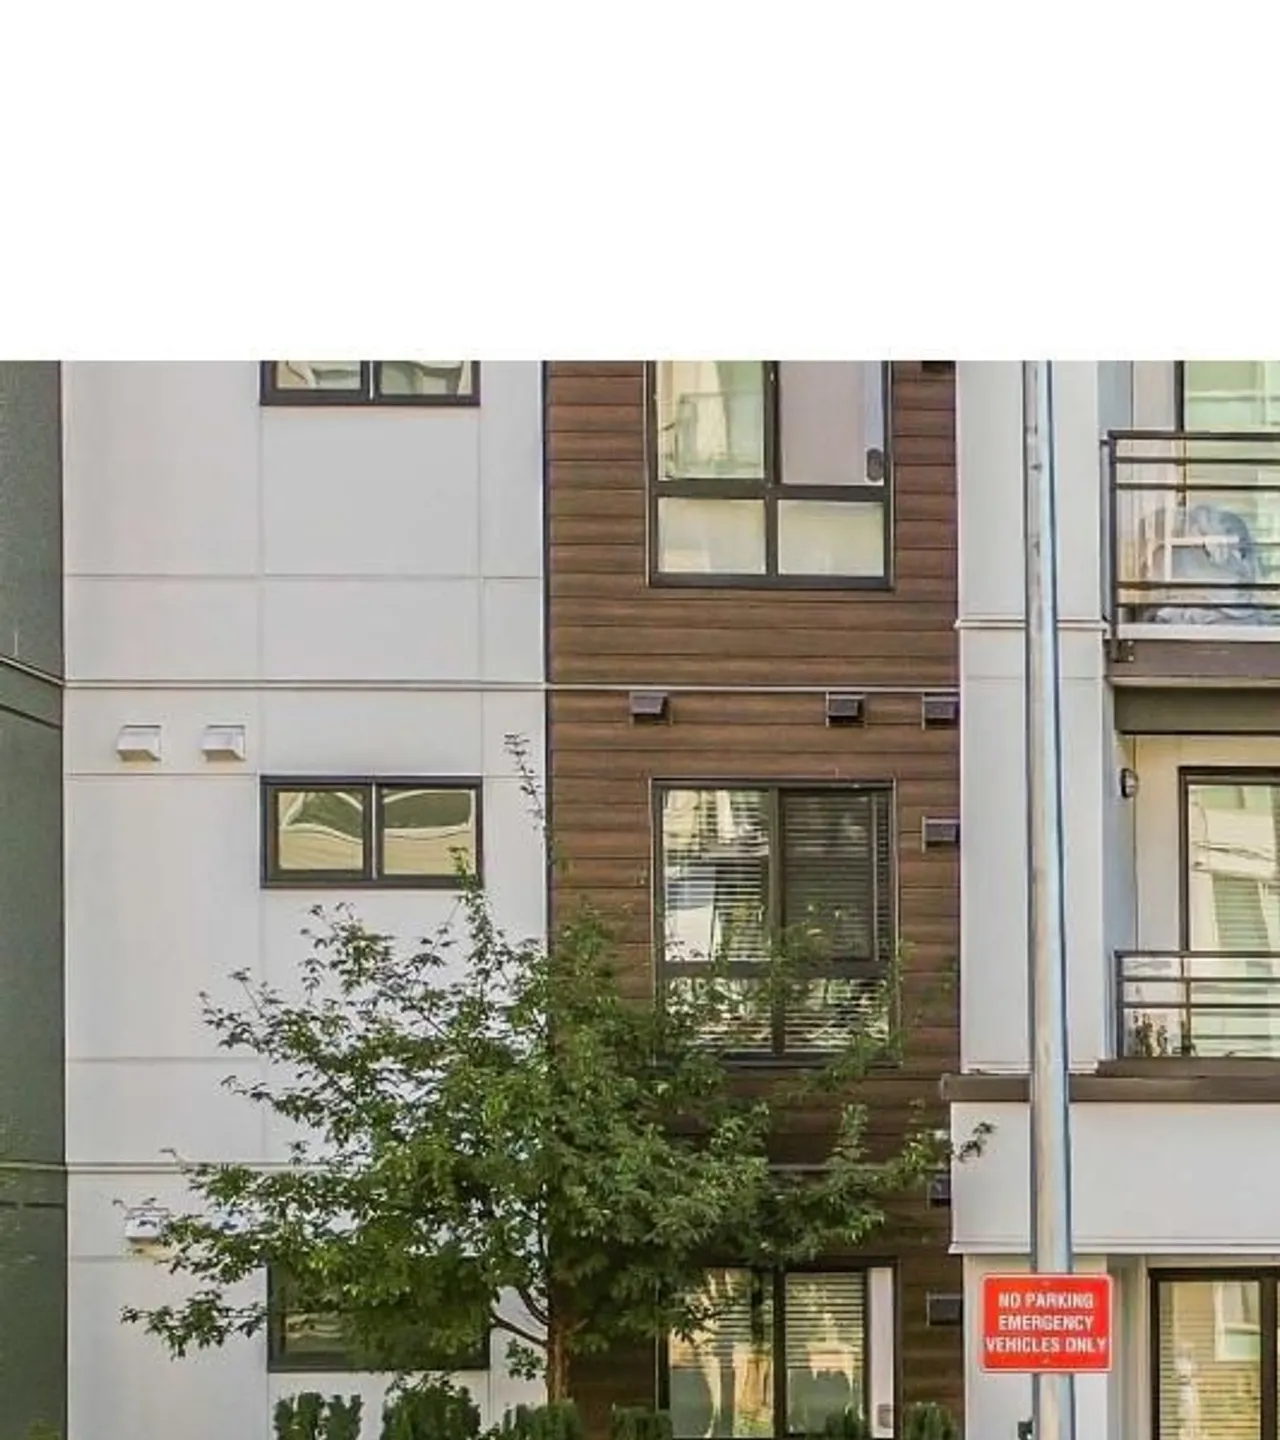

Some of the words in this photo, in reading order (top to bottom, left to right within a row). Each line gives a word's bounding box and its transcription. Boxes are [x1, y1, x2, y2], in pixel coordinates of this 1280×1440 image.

[998, 1292, 1020, 1308] NO
[1025, 1292, 1094, 1308] PARKING
[998, 1315, 1094, 1331] EMERGENCY
[986, 1337, 1060, 1353] VEHICLES
[1065, 1337, 1106, 1353] ONLY
